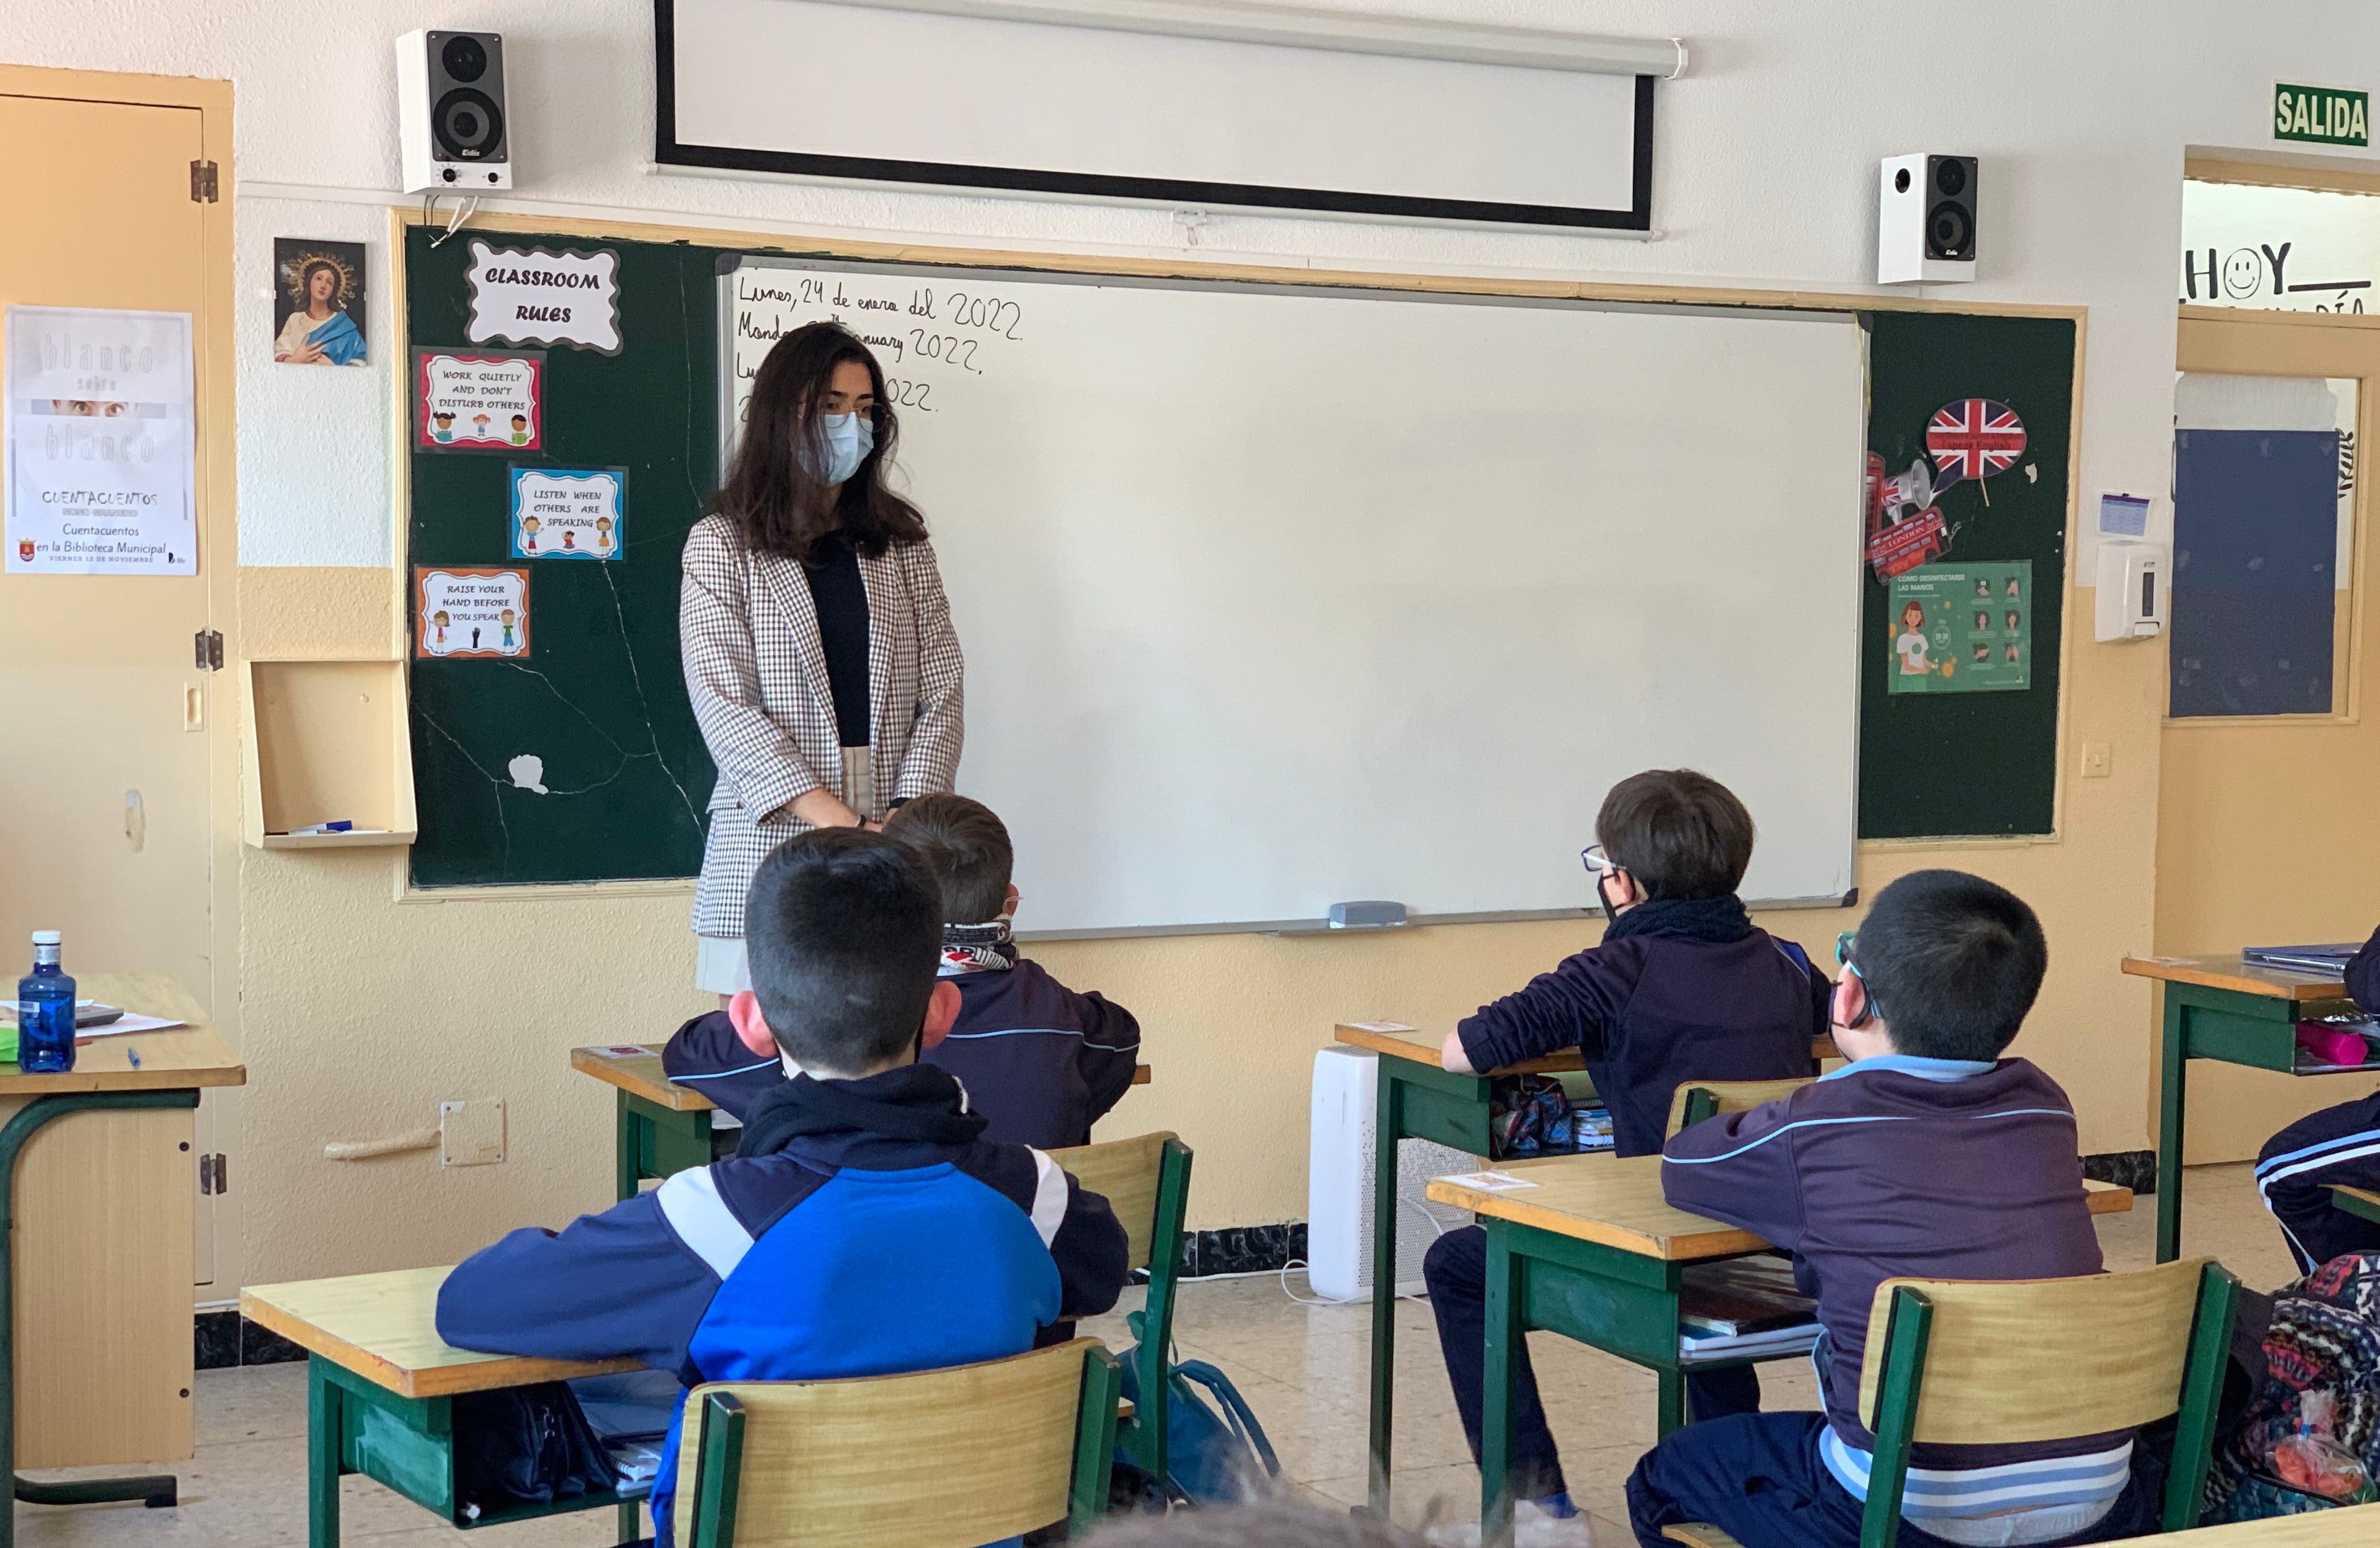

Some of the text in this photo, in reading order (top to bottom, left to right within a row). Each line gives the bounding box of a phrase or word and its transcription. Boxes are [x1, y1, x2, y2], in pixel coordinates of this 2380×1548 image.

[2277, 91, 2367, 139] SALIDA
[485, 268, 600, 290] CLASSROOM
[515, 305, 572, 323] RULES
[800, 278, 823, 303] 24
[832, 282, 851, 308] de
[909, 288, 936, 319] del
[947, 293, 1023, 341] 2022.
[443, 370, 522, 382] WORK QUIETLY
[452, 385, 513, 395] AND DON'T
[439, 399, 526, 410] DISTURB OTHERS
[42, 490, 158, 507] CUENTACUENTOS
[534, 490, 602, 500] LISTEN WHEN
[534, 504, 601, 514] OTHERS ARE
[547, 518, 594, 528] SPEAKING
[63, 523, 140, 537] Cuentacuentos
[37, 541, 167, 559] en la Biblioteca Municipal
[447, 585, 505, 593] RAISE YOUR
[442, 598, 510, 607] HAND BEFORE
